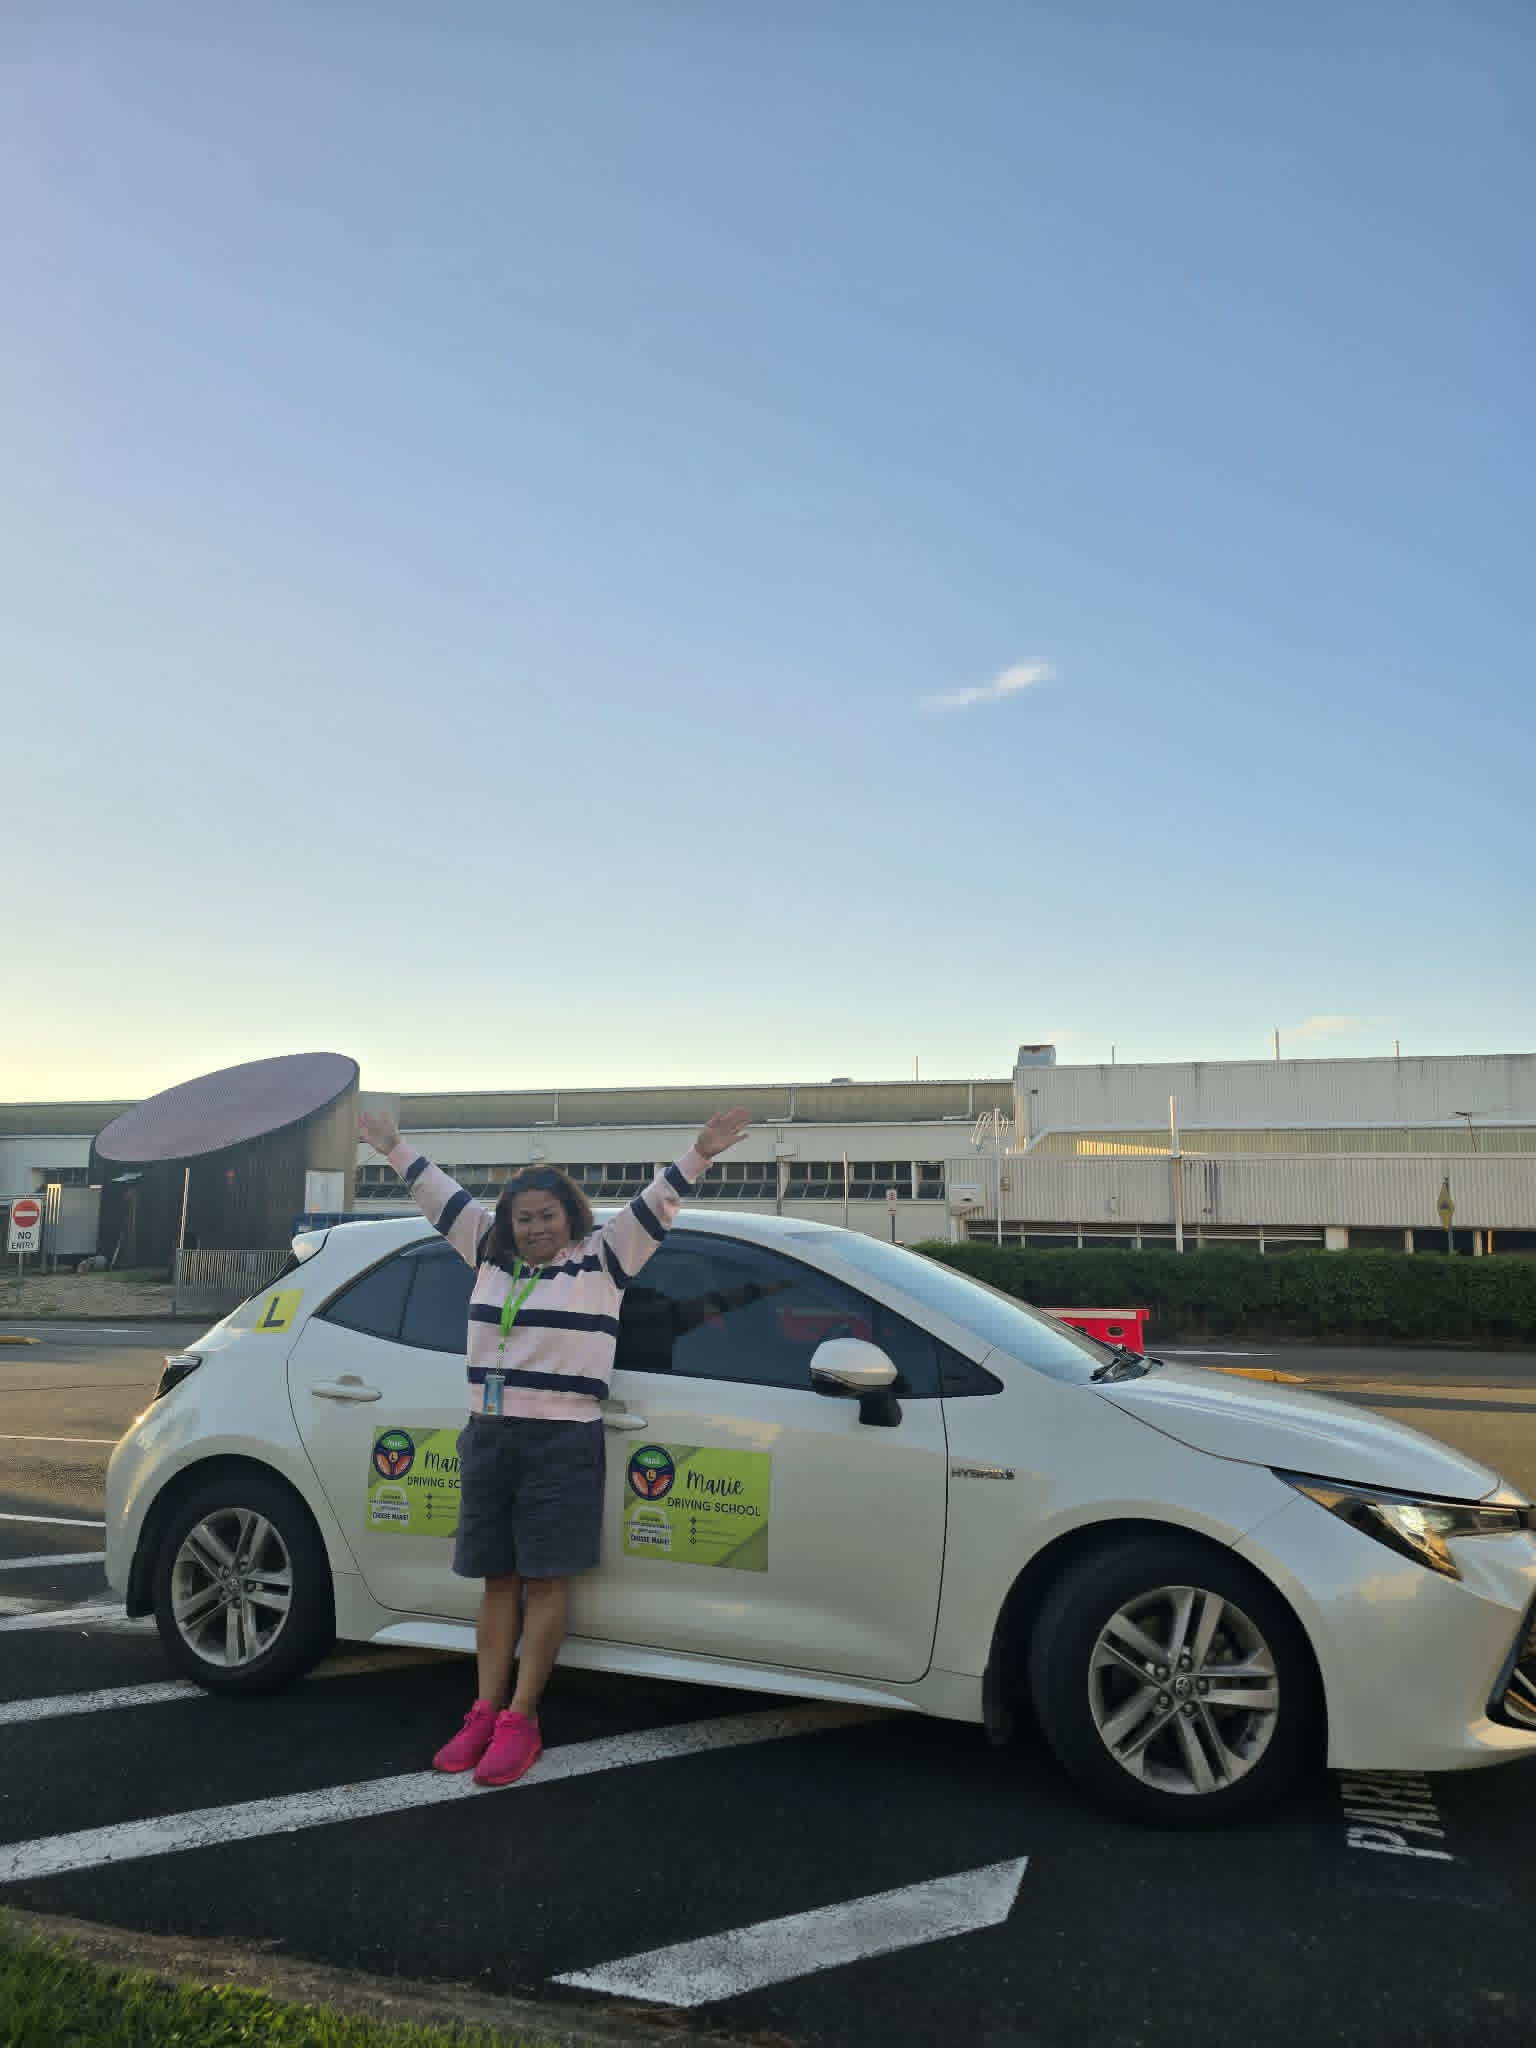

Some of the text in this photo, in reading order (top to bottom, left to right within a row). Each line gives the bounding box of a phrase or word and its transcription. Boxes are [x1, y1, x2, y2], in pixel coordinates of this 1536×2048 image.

[17, 1231, 32, 1240] NO
[11, 1242, 34, 1250] ENTRY
[262, 1296, 285, 1328] L
[424, 1450, 463, 1472] Mar
[407, 1476, 445, 1489] DRIVING
[686, 1469, 745, 1496] Marie
[667, 1497, 761, 1517] DRIVING SCHOOL
